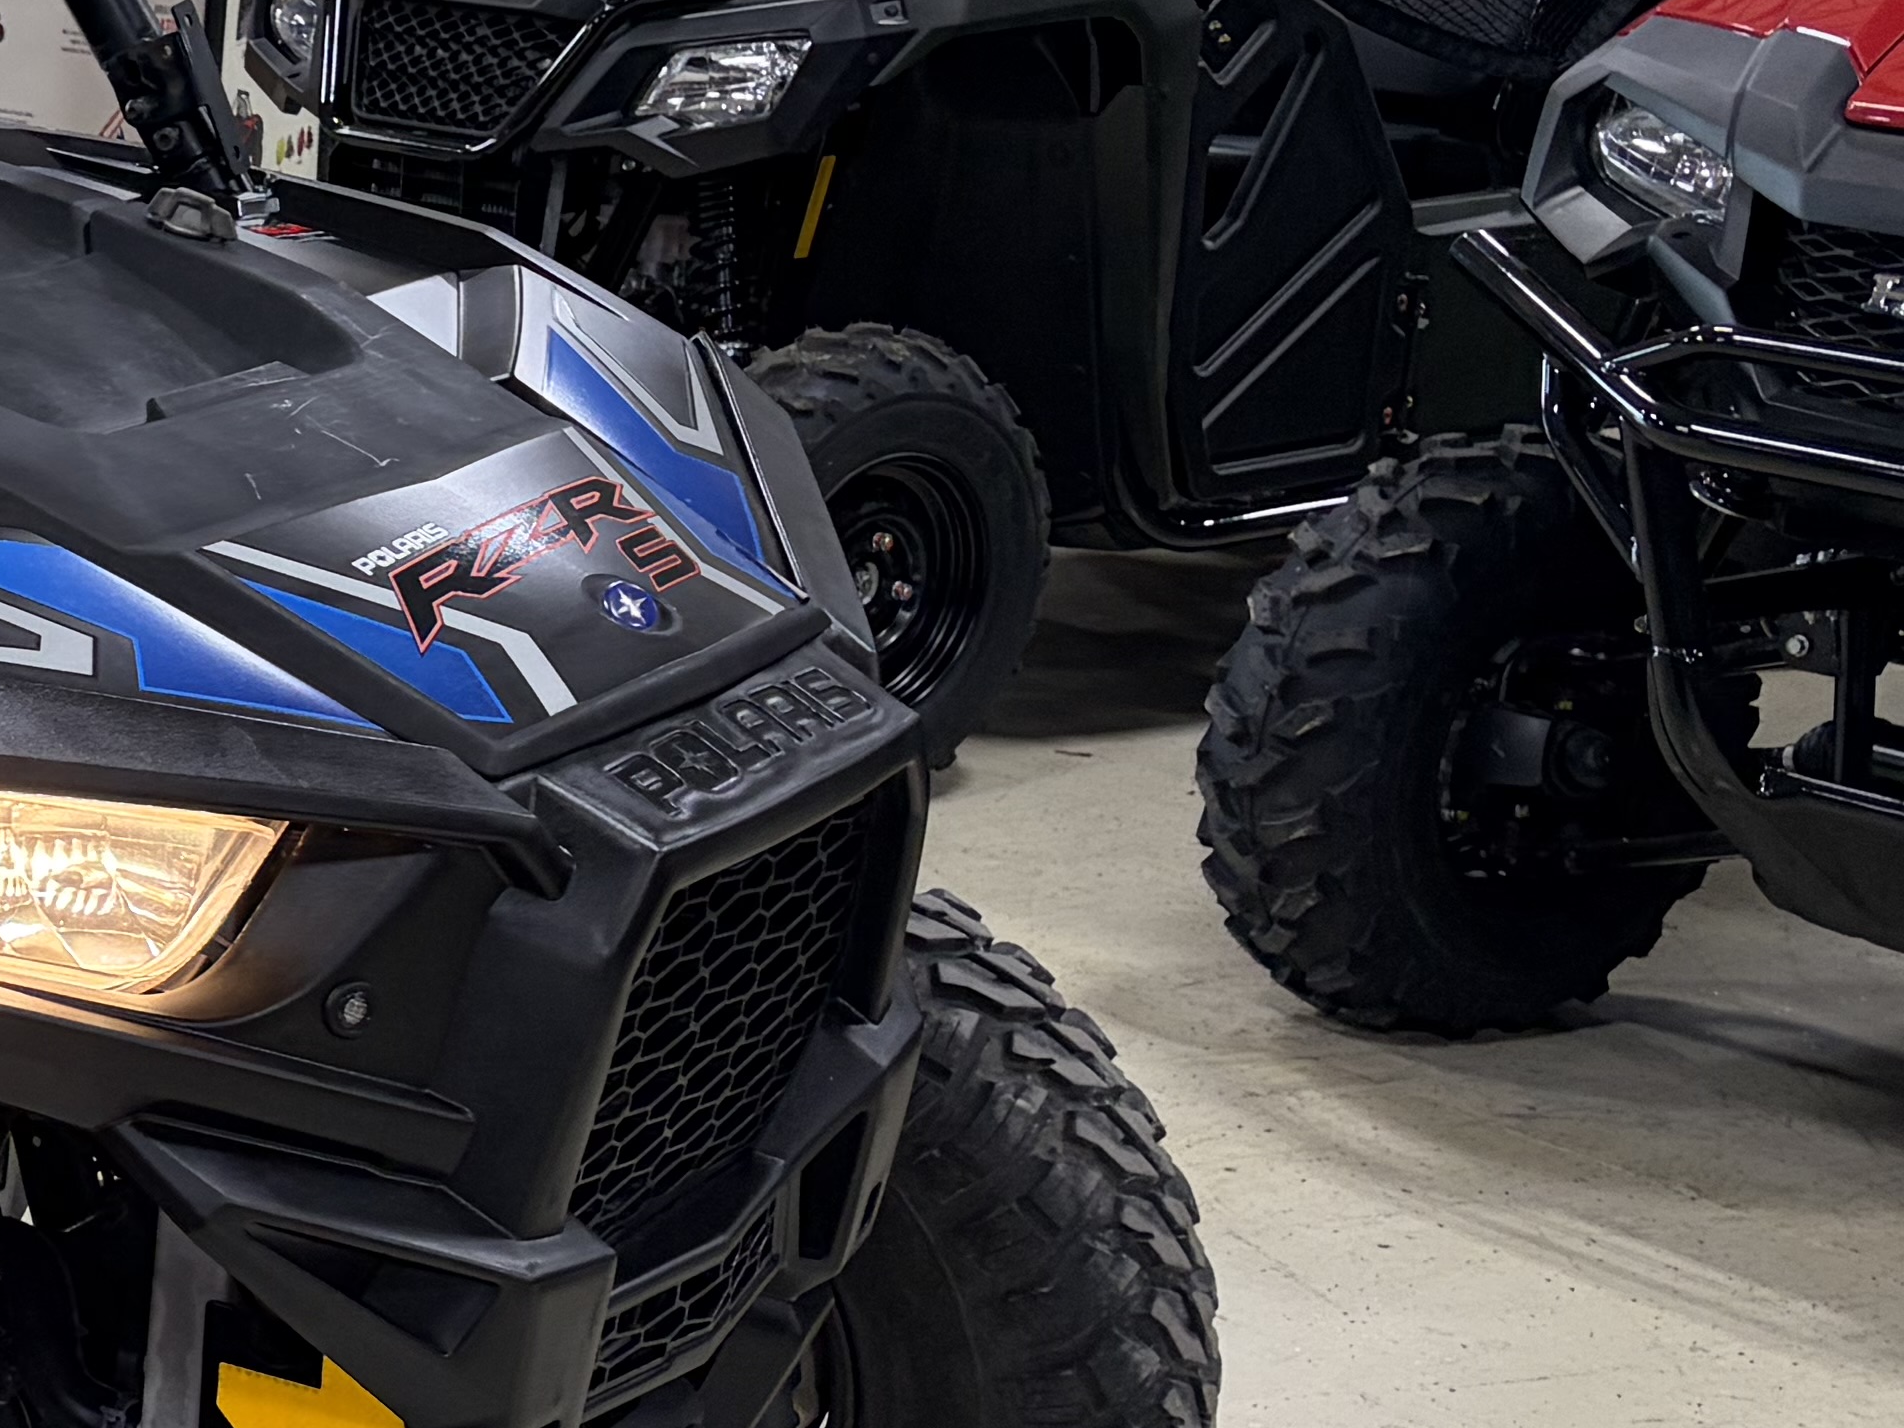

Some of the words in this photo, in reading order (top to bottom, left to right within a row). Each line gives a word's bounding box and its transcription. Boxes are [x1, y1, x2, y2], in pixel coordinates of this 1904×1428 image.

[350, 521, 449, 577] POLARIS
[388, 475, 658, 657] RZR
[615, 525, 702, 593] S
[602, 665, 878, 821] POLARIS
